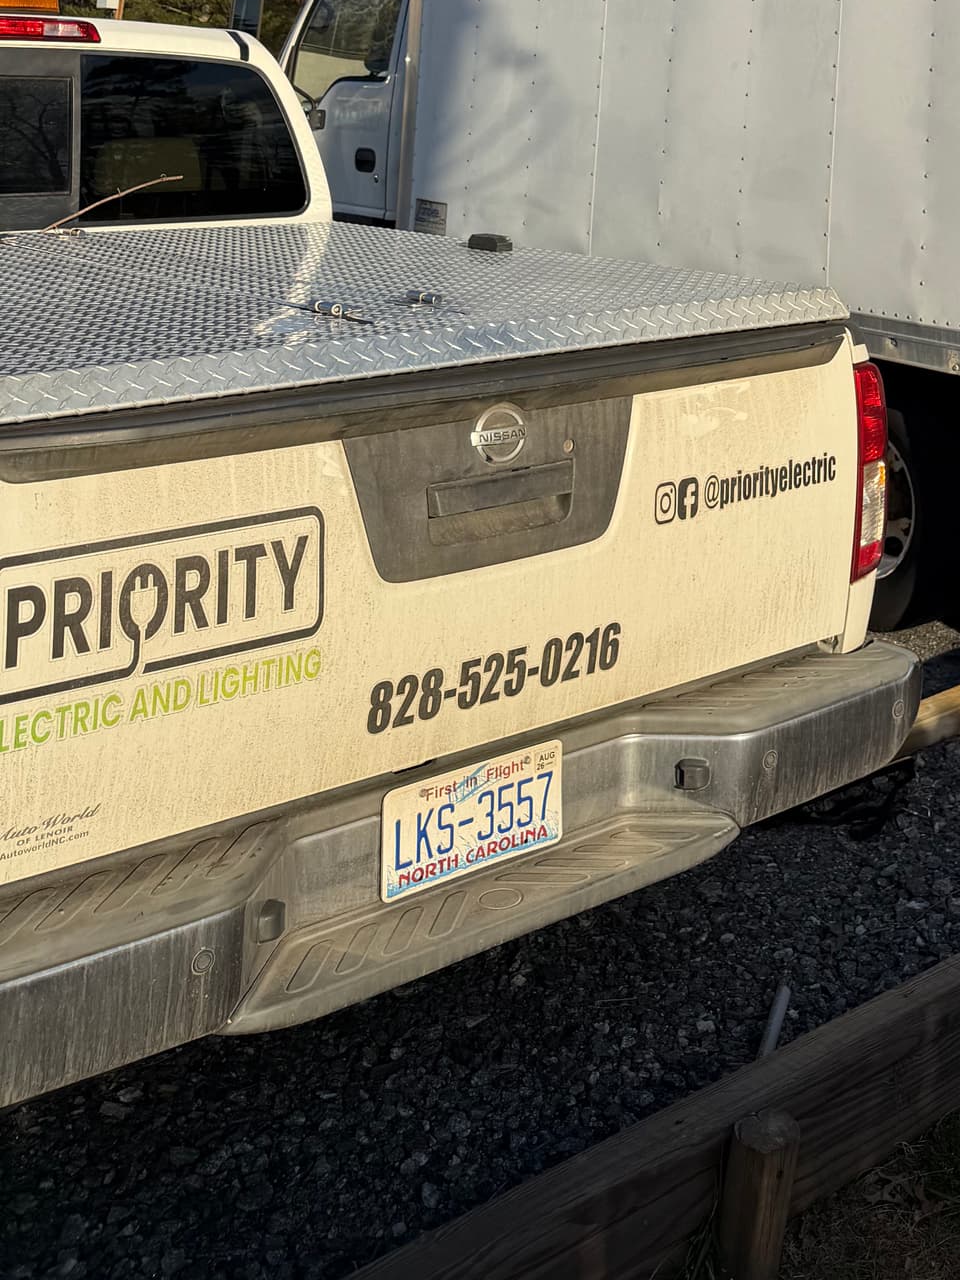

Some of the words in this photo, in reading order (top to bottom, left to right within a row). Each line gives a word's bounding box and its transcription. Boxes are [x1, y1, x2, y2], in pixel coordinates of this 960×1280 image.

[479, 426, 526, 443] NISSAN
[704, 452, 836, 509] @priorityelectric
[5, 535, 309, 669] PRIORITY
[130, 677, 192, 722] AND
[198, 647, 323, 706] LIGHTING
[366, 621, 622, 735] 828-525-0216
[426, 780, 457, 801] First
[486, 759, 525, 783] Flight
[538, 751, 556, 762] AUG
[16, 837, 31, 846] OF
[35, 825, 73, 841] LENOIR
[42, 802, 101, 830] World
[394, 770, 554, 871] LKS-3557
[398, 853, 459, 889] NORTH
[465, 824, 548, 864] CAROLINA
